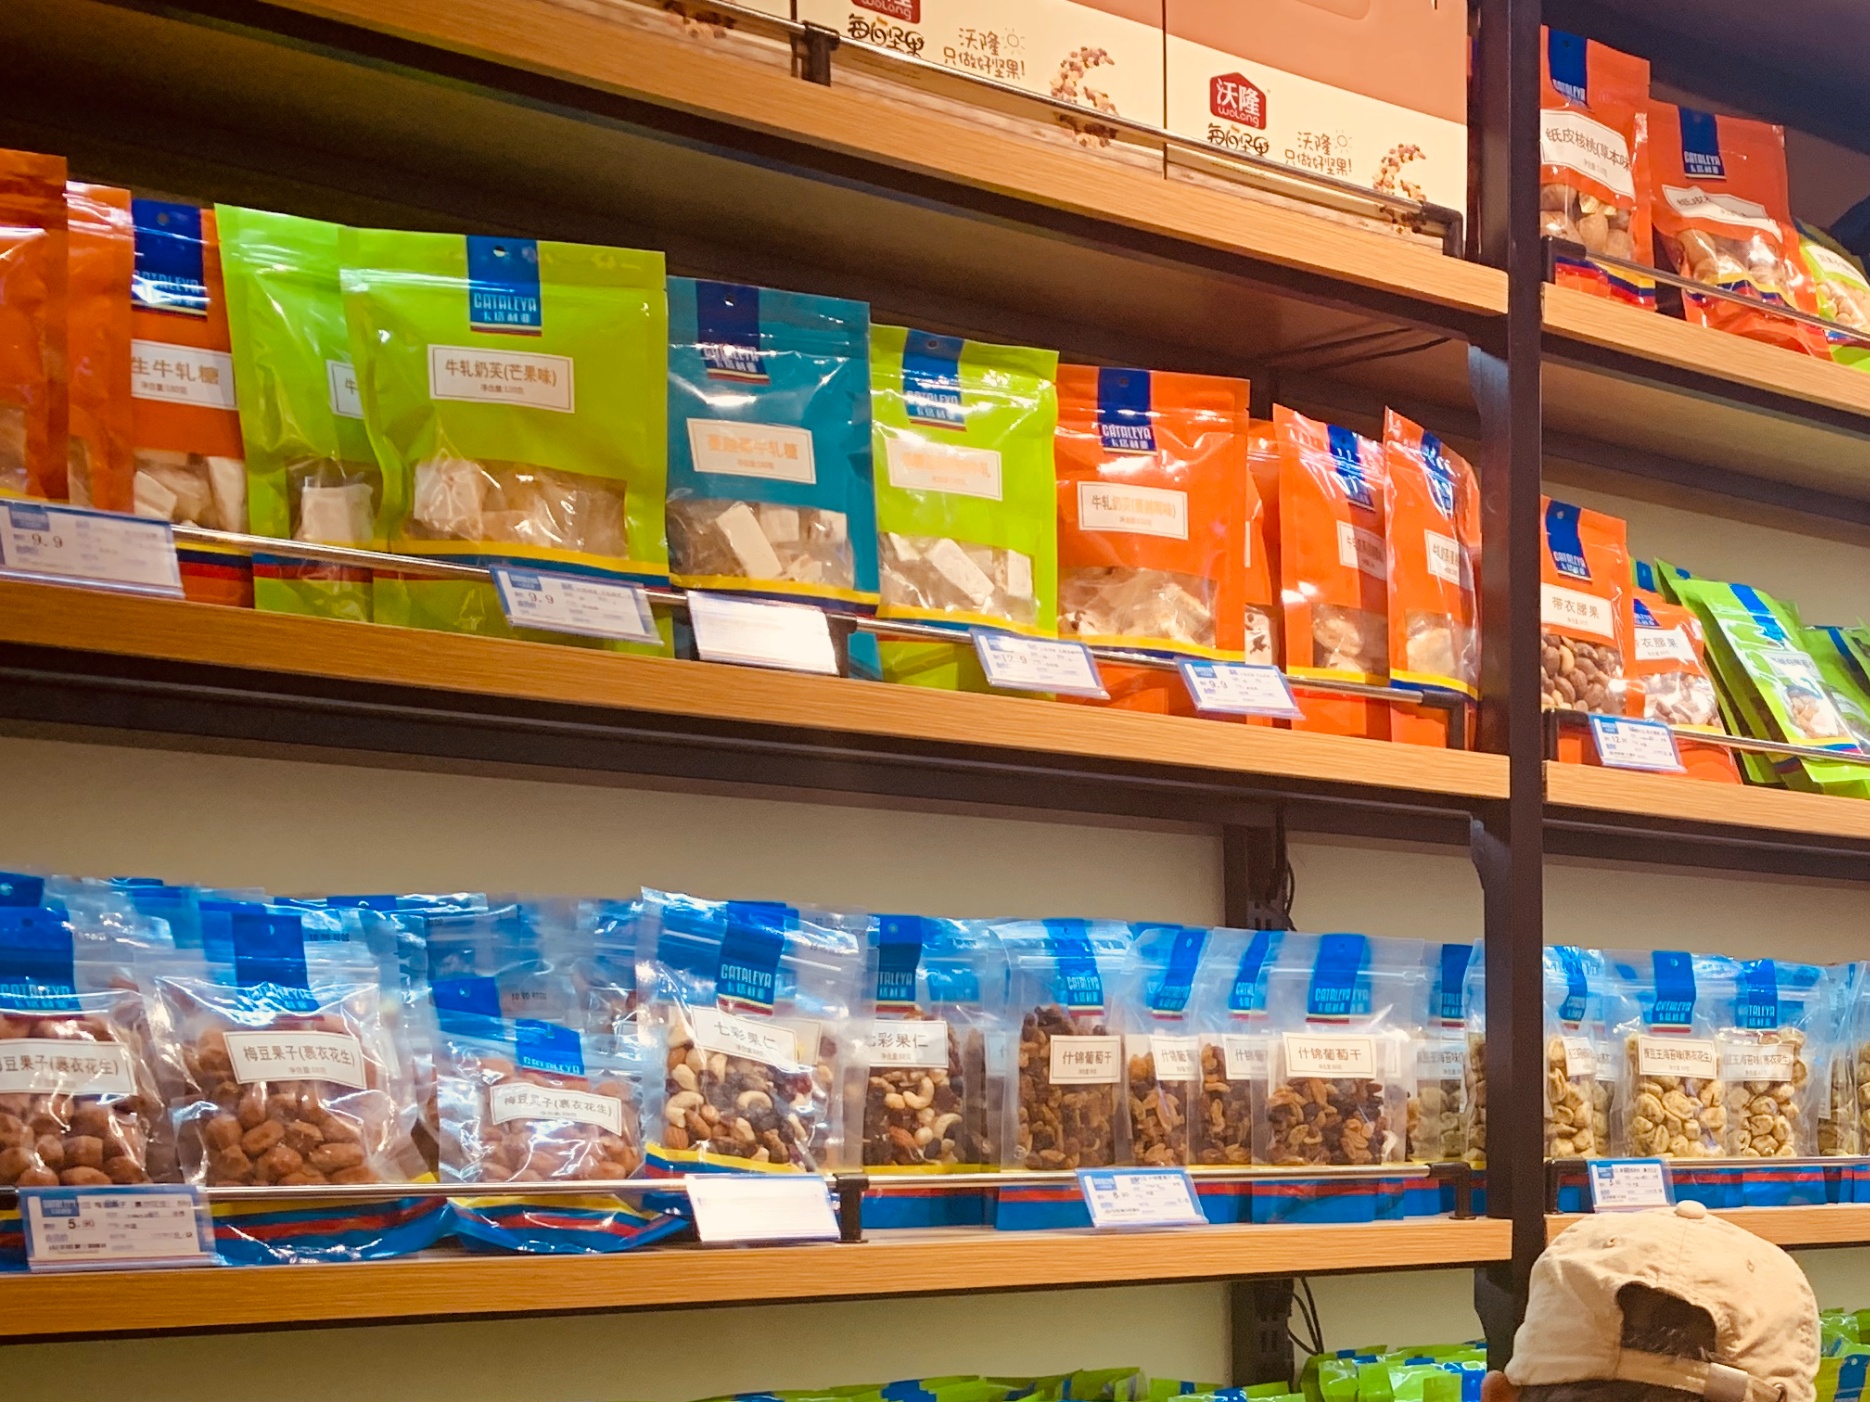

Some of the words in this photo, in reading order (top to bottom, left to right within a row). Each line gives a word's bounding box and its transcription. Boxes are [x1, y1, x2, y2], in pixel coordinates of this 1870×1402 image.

[958, 28, 1001, 55] 沃隆
[943, 47, 1026, 80] 只做好坚果!
[1217, 78, 1260, 117] 沃隆
[1218, 106, 1260, 127] wolong
[1297, 132, 1331, 155] 沃隆
[1285, 150, 1353, 176] 只做好坚果!
[1684, 150, 1722, 166] CATALEYA
[472, 291, 537, 313] CATALEYA
[444, 358, 558, 389] 牛轧奶芙(芒果味)
[1102, 421, 1152, 441] CATALEYA
[1552, 596, 1600, 620] 带衣腰果
[721, 963, 772, 989] CATALEYA
[876, 971, 913, 987] TALEYA
[1066, 975, 1100, 990] CATALEYA
[713, 1021, 777, 1050] 七彩果仁
[243, 1045, 356, 1068] 梅豆果子(裹衣花生)
[1062, 1050, 1113, 1066] 什锦葡萄干
[1297, 1047, 1362, 1062] 什锦葡萄干
